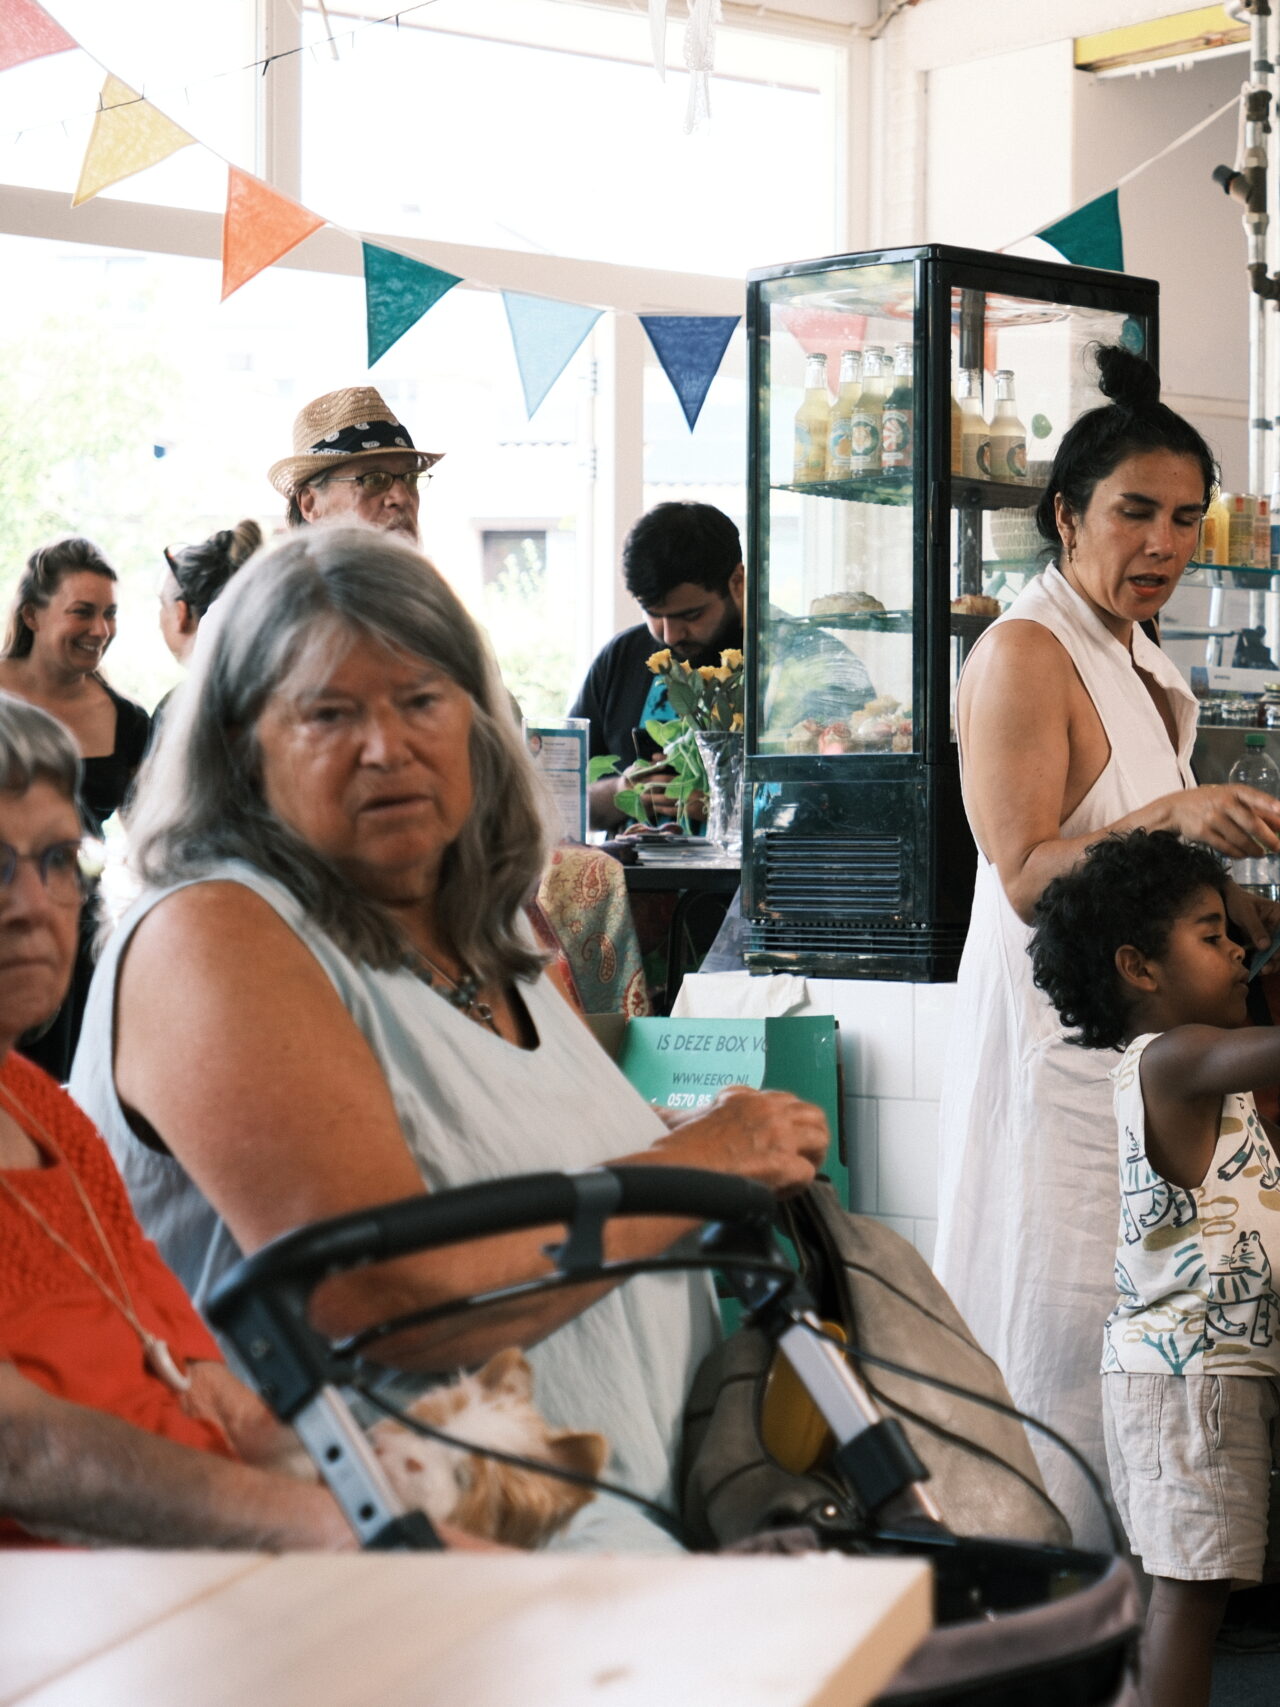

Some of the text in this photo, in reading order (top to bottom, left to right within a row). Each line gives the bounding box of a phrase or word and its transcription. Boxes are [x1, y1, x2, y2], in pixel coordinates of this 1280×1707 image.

[657, 1034, 671, 1050] IS
[673, 1034, 713, 1051] DEZE
[715, 1035, 748, 1052] BOX
[672, 1071, 750, 1087] WWW.EEKONL
[667, 1092, 693, 1107] 0570
